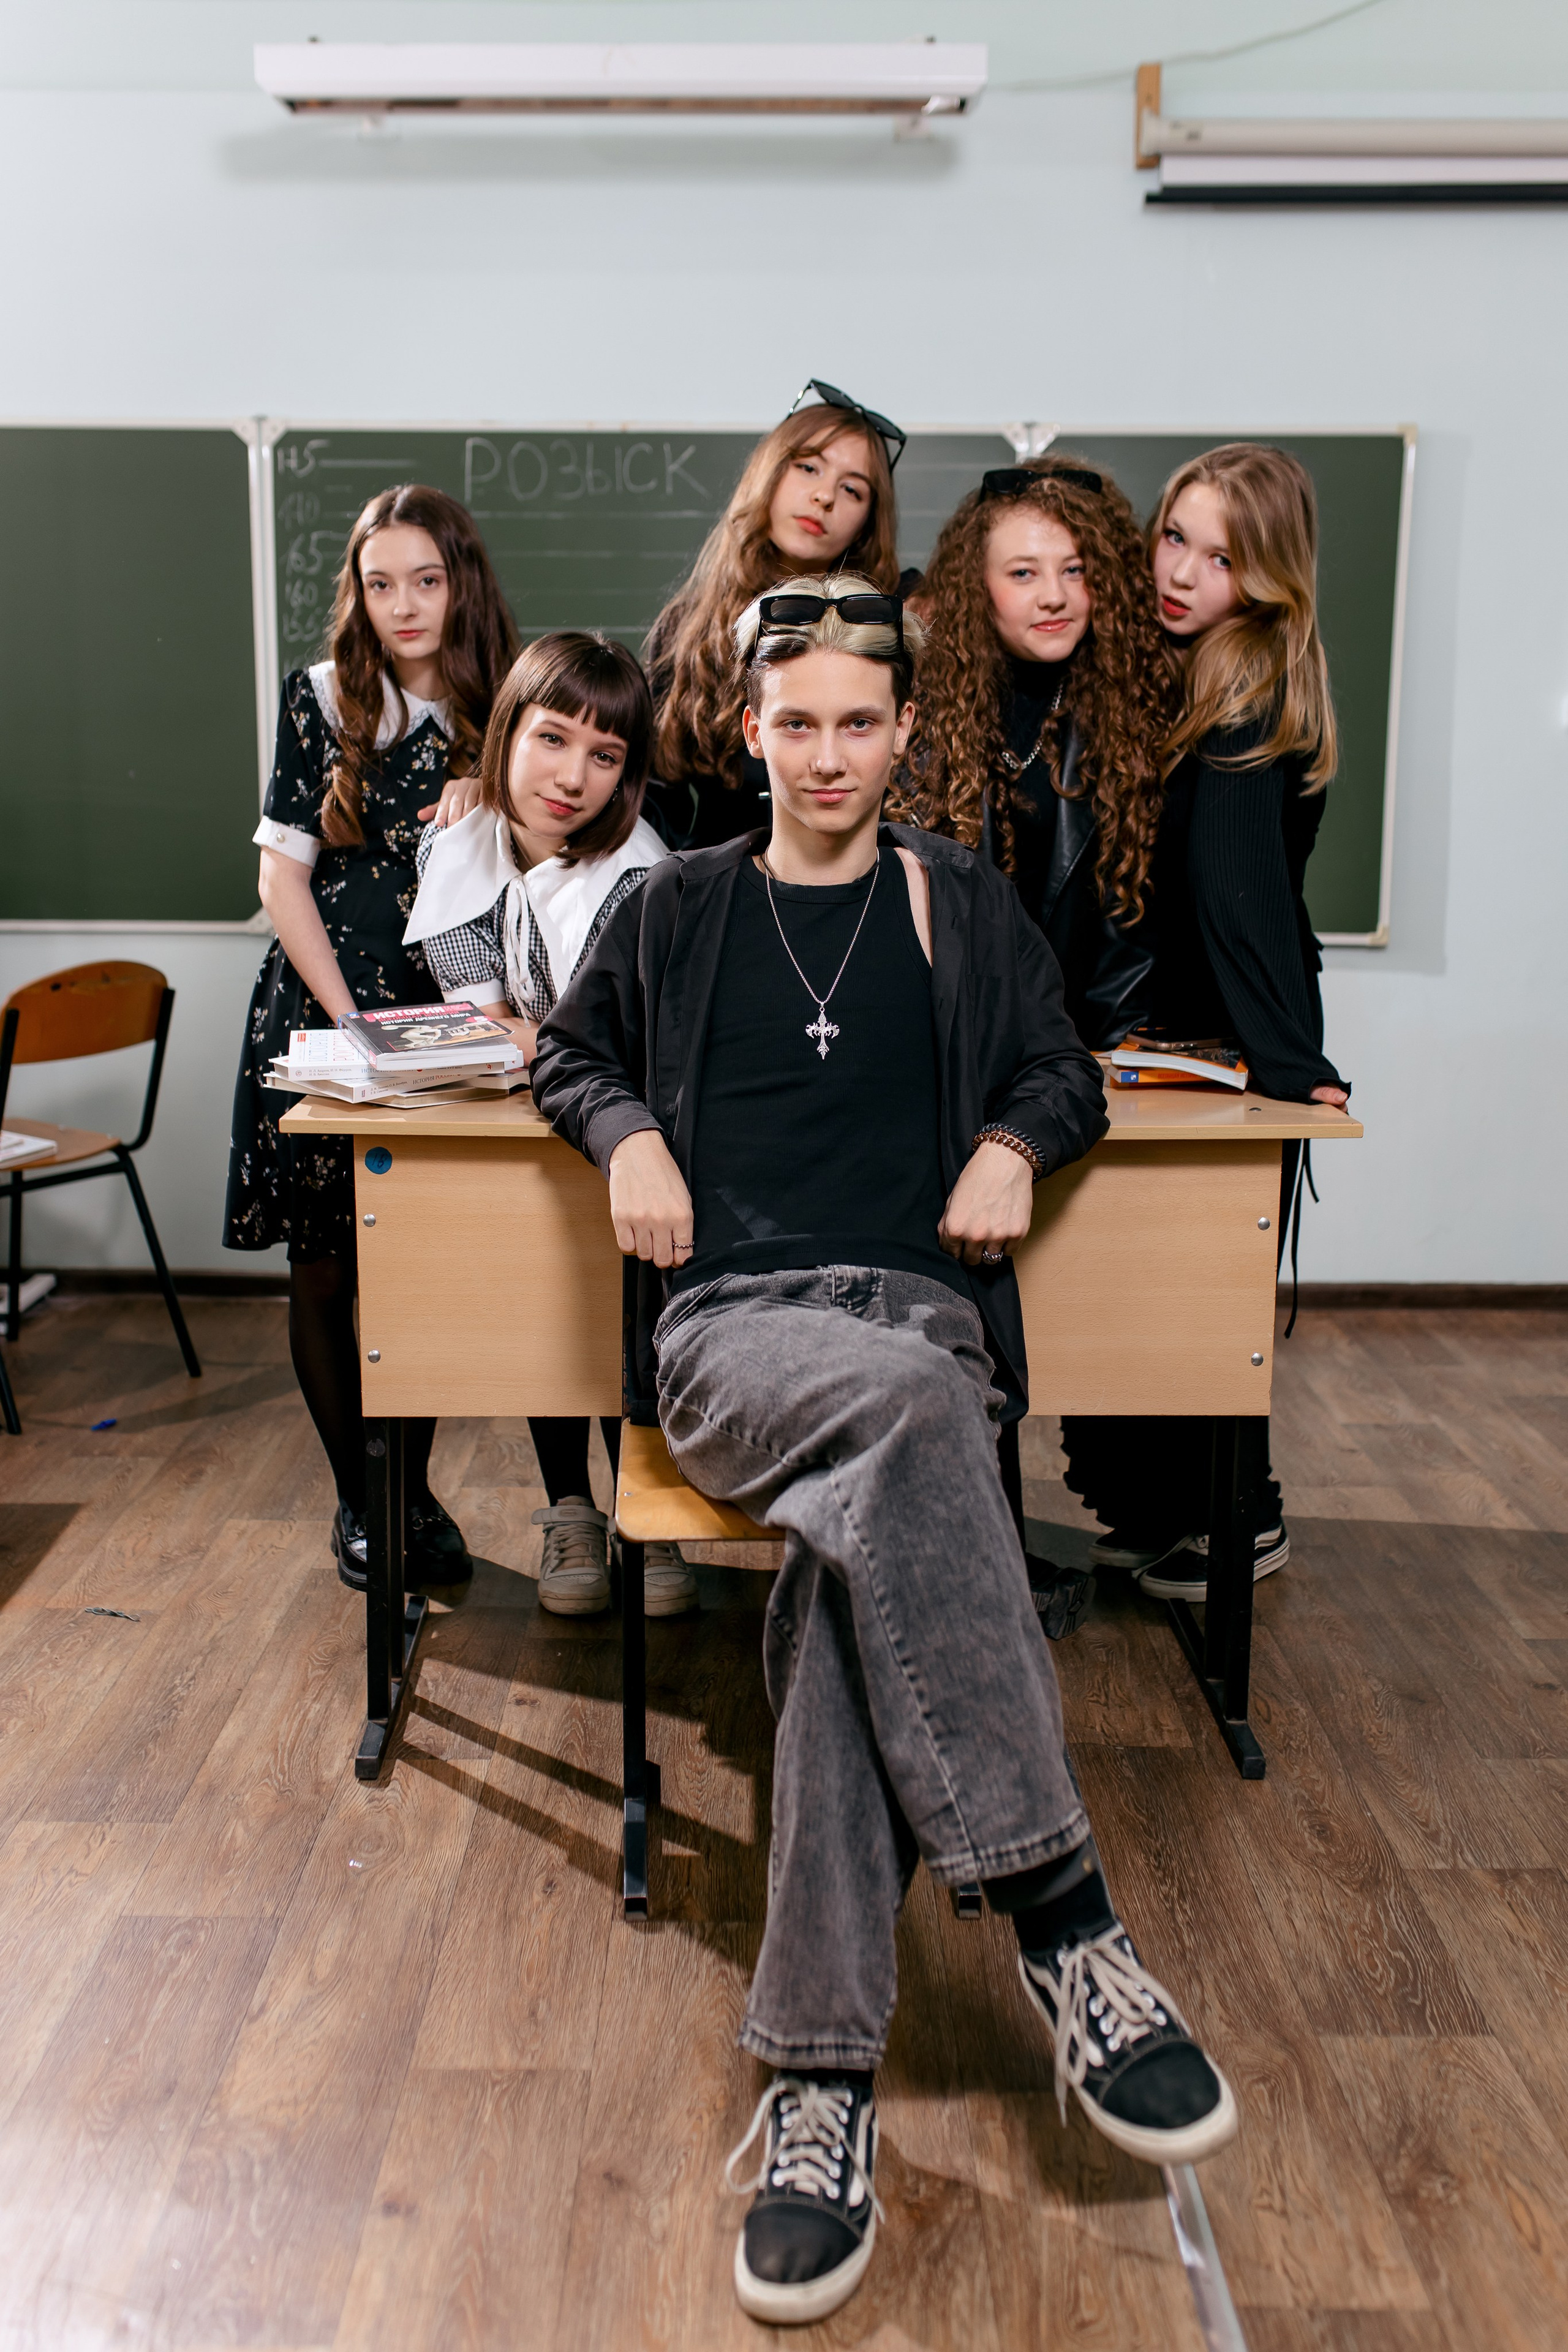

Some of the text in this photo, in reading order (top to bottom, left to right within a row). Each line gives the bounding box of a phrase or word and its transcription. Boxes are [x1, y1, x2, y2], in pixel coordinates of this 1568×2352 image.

[464, 437, 710, 503] РОЗЫСК
[372, 1006, 446, 1020] ИСТОРИЯ
[309, 1033, 328, 1062] ИСТОРИЯ
[413, 1075, 435, 1085] ИСТОРИЯ
